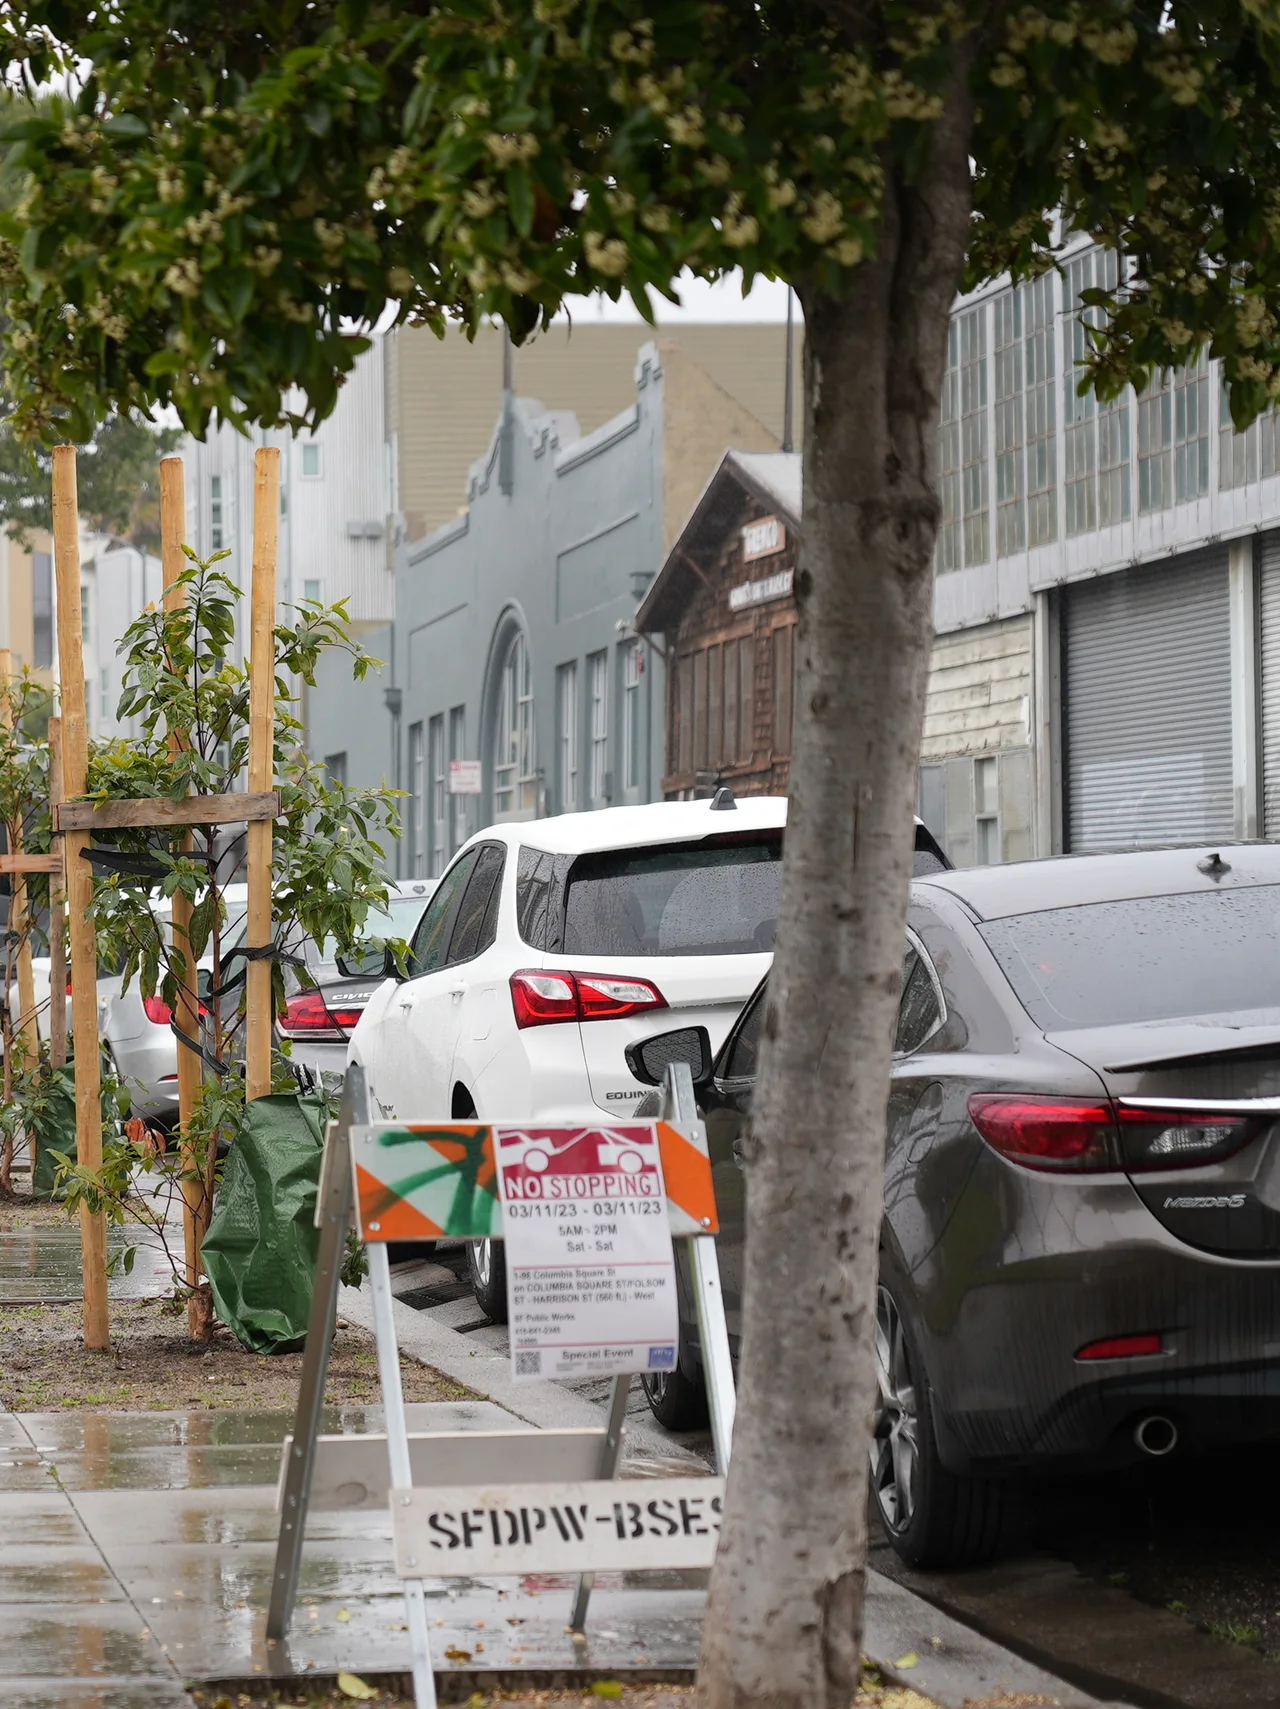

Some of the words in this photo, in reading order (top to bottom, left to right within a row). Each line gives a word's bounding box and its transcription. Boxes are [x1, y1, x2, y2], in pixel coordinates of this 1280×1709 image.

[332, 992, 373, 1001] CIVIC
[505, 1176, 542, 1199] NO
[550, 1175, 651, 1198] STOPPING
[509, 1204, 577, 1218] 03/11/23
[594, 1201, 661, 1216] 03/11/23
[559, 1225, 583, 1237] 5AM
[594, 1224, 617, 1236] 2PM
[567, 1241, 585, 1252] Sat
[595, 1241, 614, 1252] Sat
[533, 1270, 573, 1280] Columbia
[576, 1269, 604, 1280] Square
[527, 1282, 573, 1292] COLUMBIA
[577, 1281, 613, 1291] SQUARE
[615, 1279, 665, 1289] ST/FOLSOM
[533, 1294, 579, 1304] HARRISON
[634, 1291, 655, 1300] West
[526, 1313, 549, 1322] Public
[552, 1312, 575, 1321] Works
[562, 1349, 601, 1361] Special
[604, 1348, 633, 1358] Event
